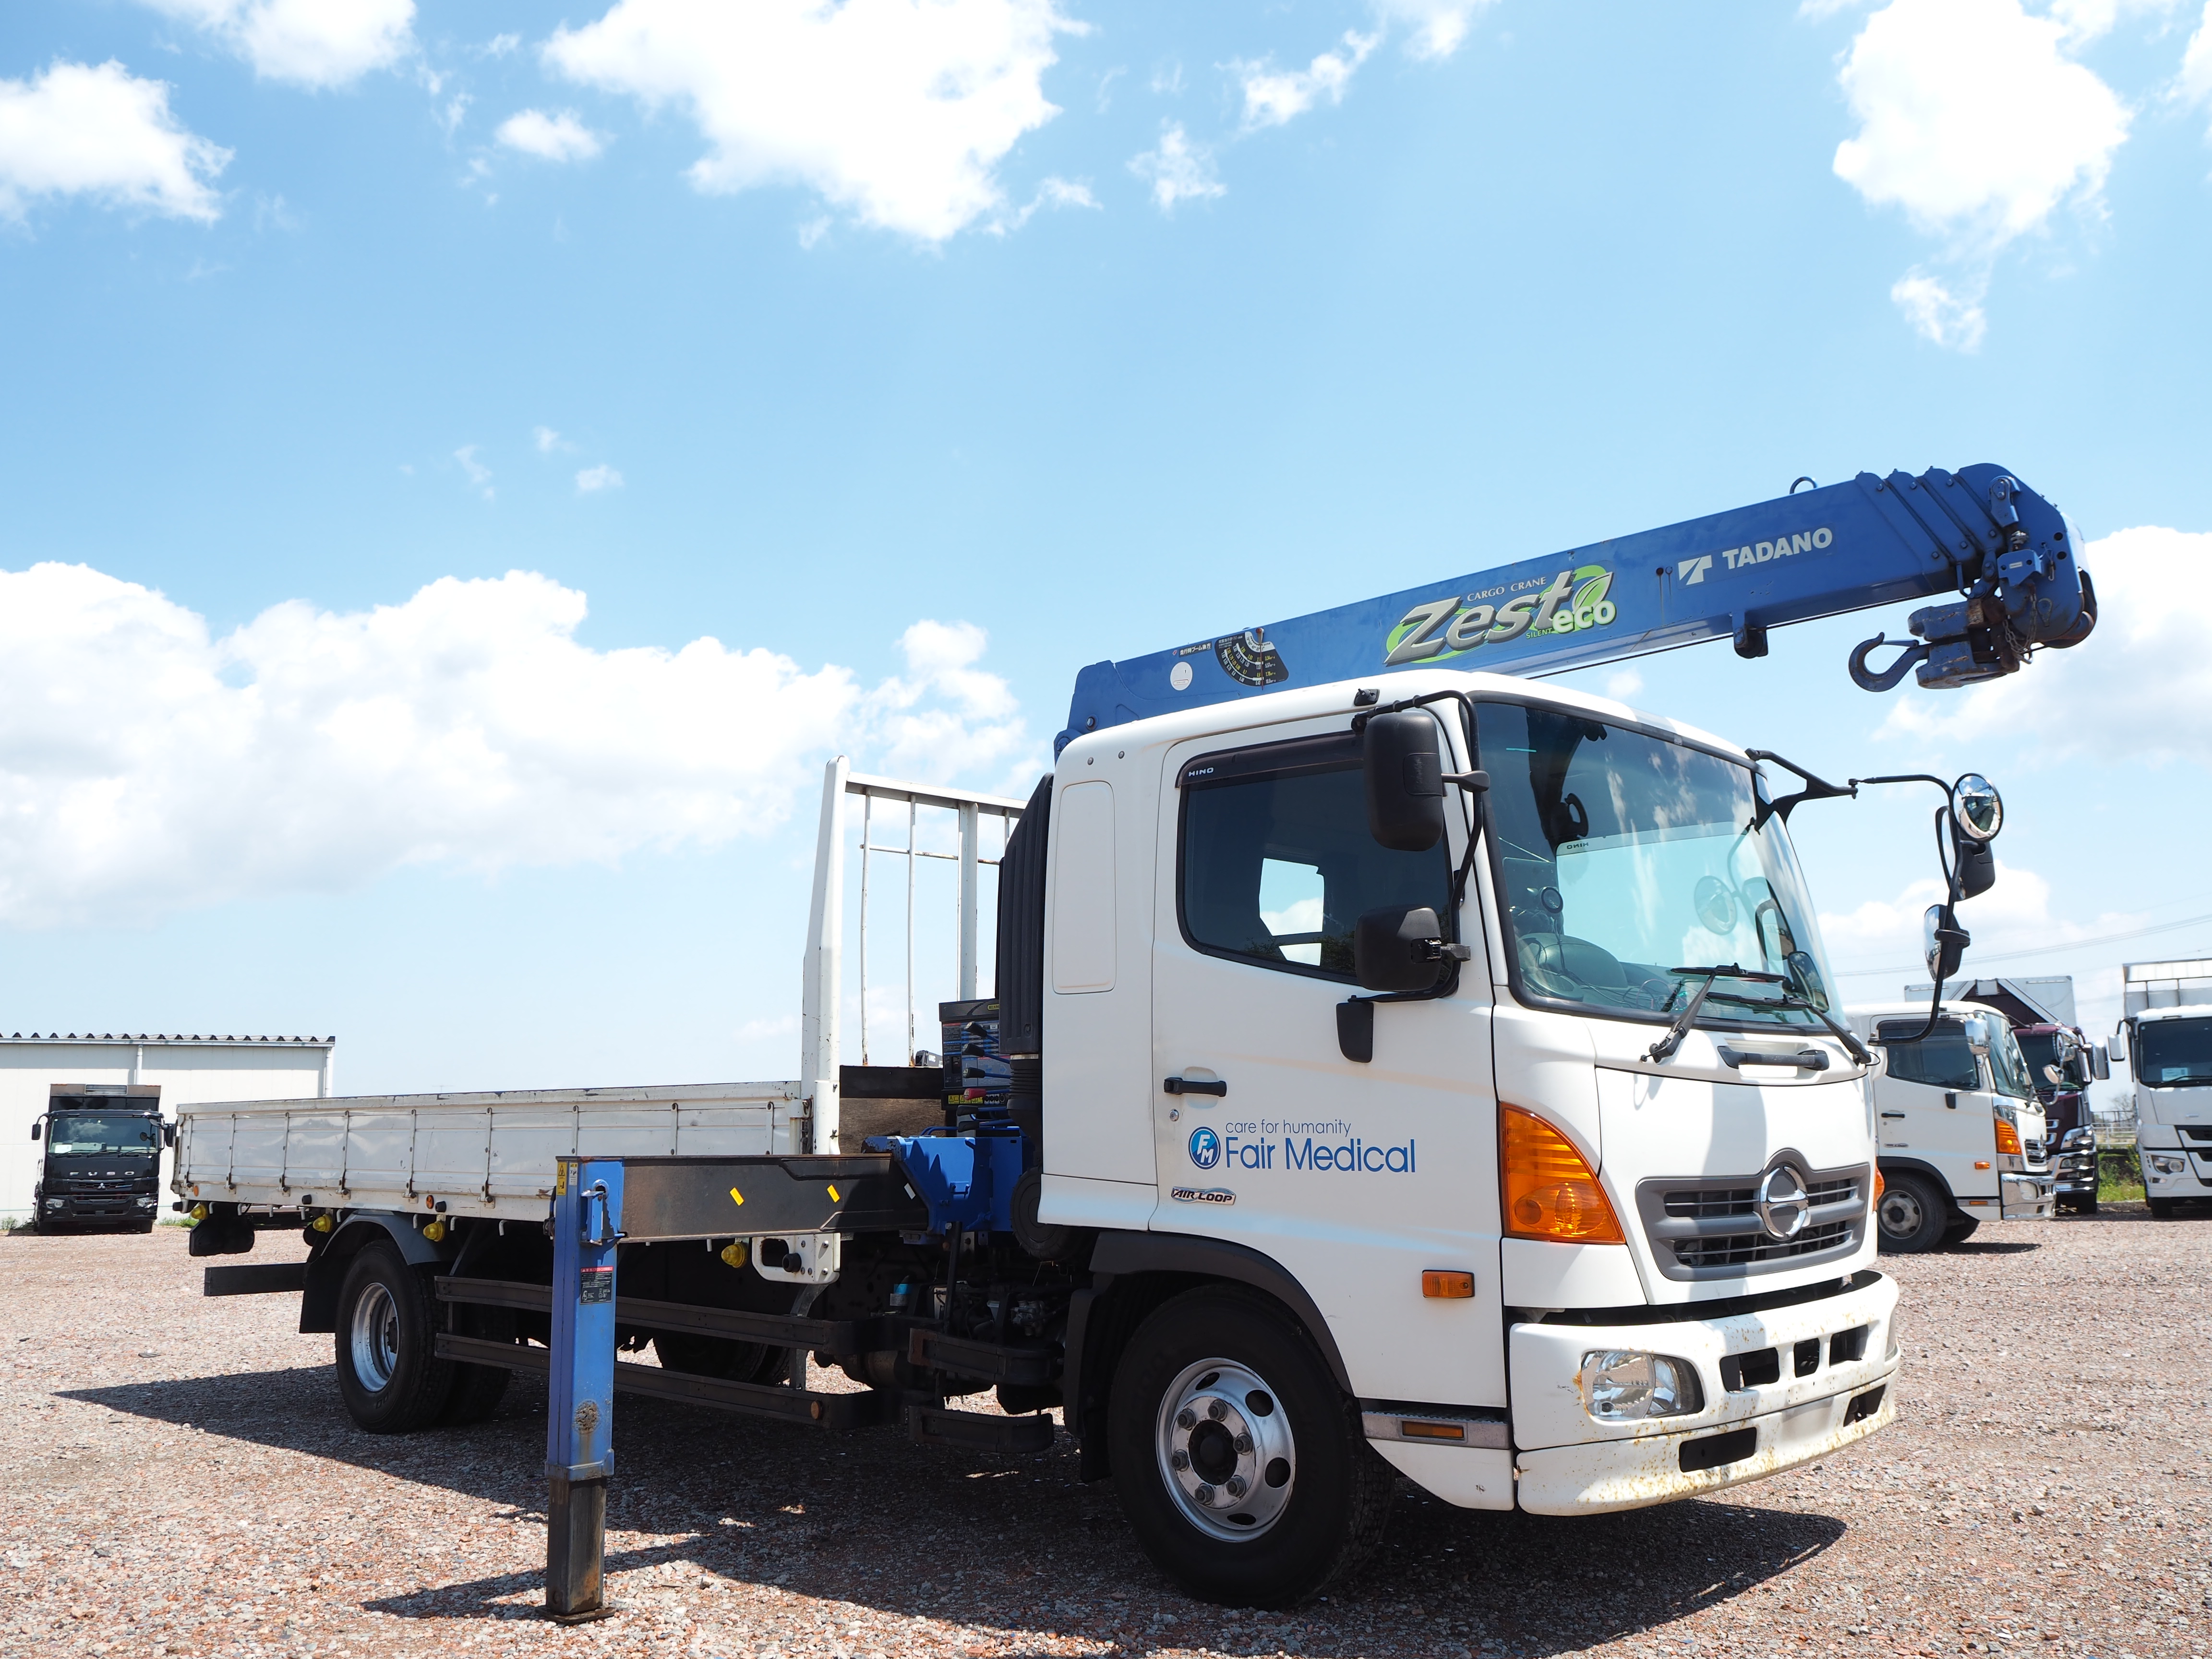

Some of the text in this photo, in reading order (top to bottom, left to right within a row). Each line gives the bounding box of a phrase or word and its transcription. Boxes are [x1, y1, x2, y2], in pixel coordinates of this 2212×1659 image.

[1722, 527, 1833, 569] TADANO
[1467, 577, 1547, 602] CARGO CRANE
[1383, 570, 1573, 666] Zest
[1526, 600, 1617, 639] SILENT eco
[1188, 767, 1214, 777] HINO
[1226, 1119, 1351, 1137] care for humanity
[1226, 1137, 1416, 1172] Fair Medical
[1173, 1190, 1233, 1202] AIR LOOP
